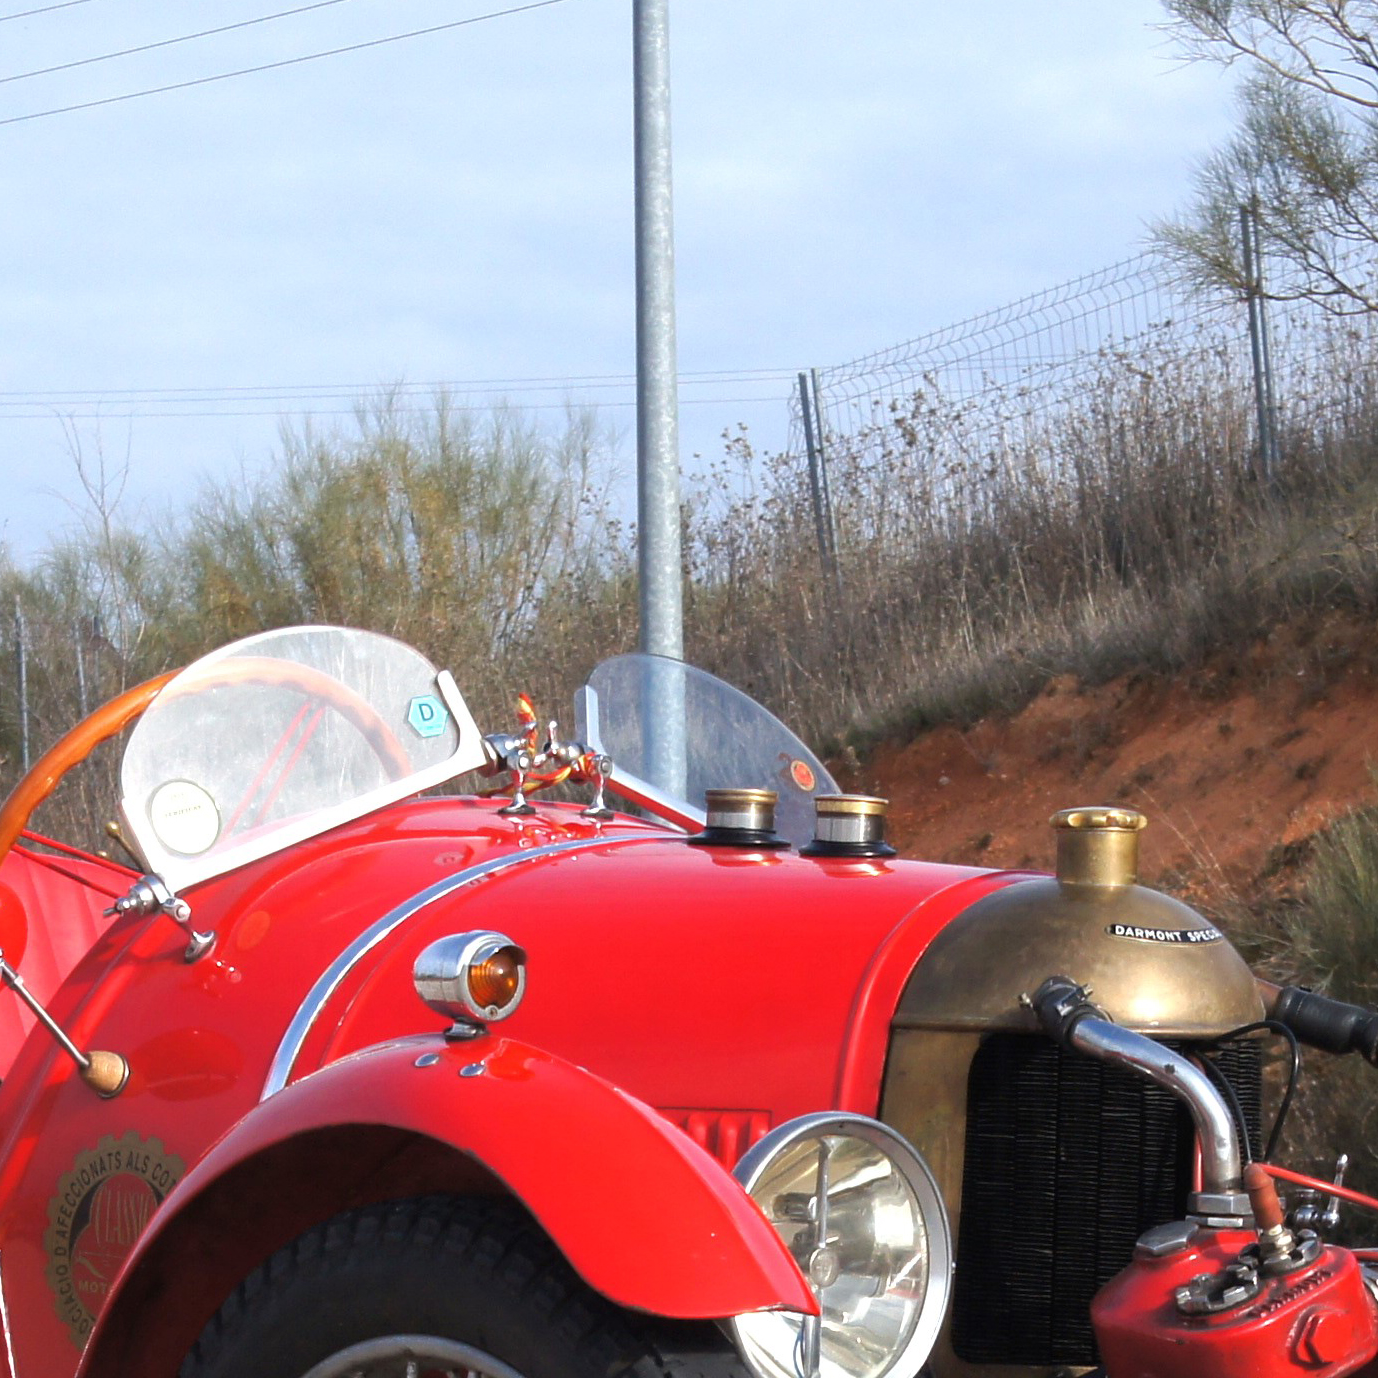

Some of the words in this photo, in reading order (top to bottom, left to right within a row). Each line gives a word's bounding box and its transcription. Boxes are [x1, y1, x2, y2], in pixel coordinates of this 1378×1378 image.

[418, 703, 434, 722] D
[1115, 924, 1182, 942] DARMONT
[126, 1150, 151, 1174] ALS
[78, 1279, 109, 1295] MOT
